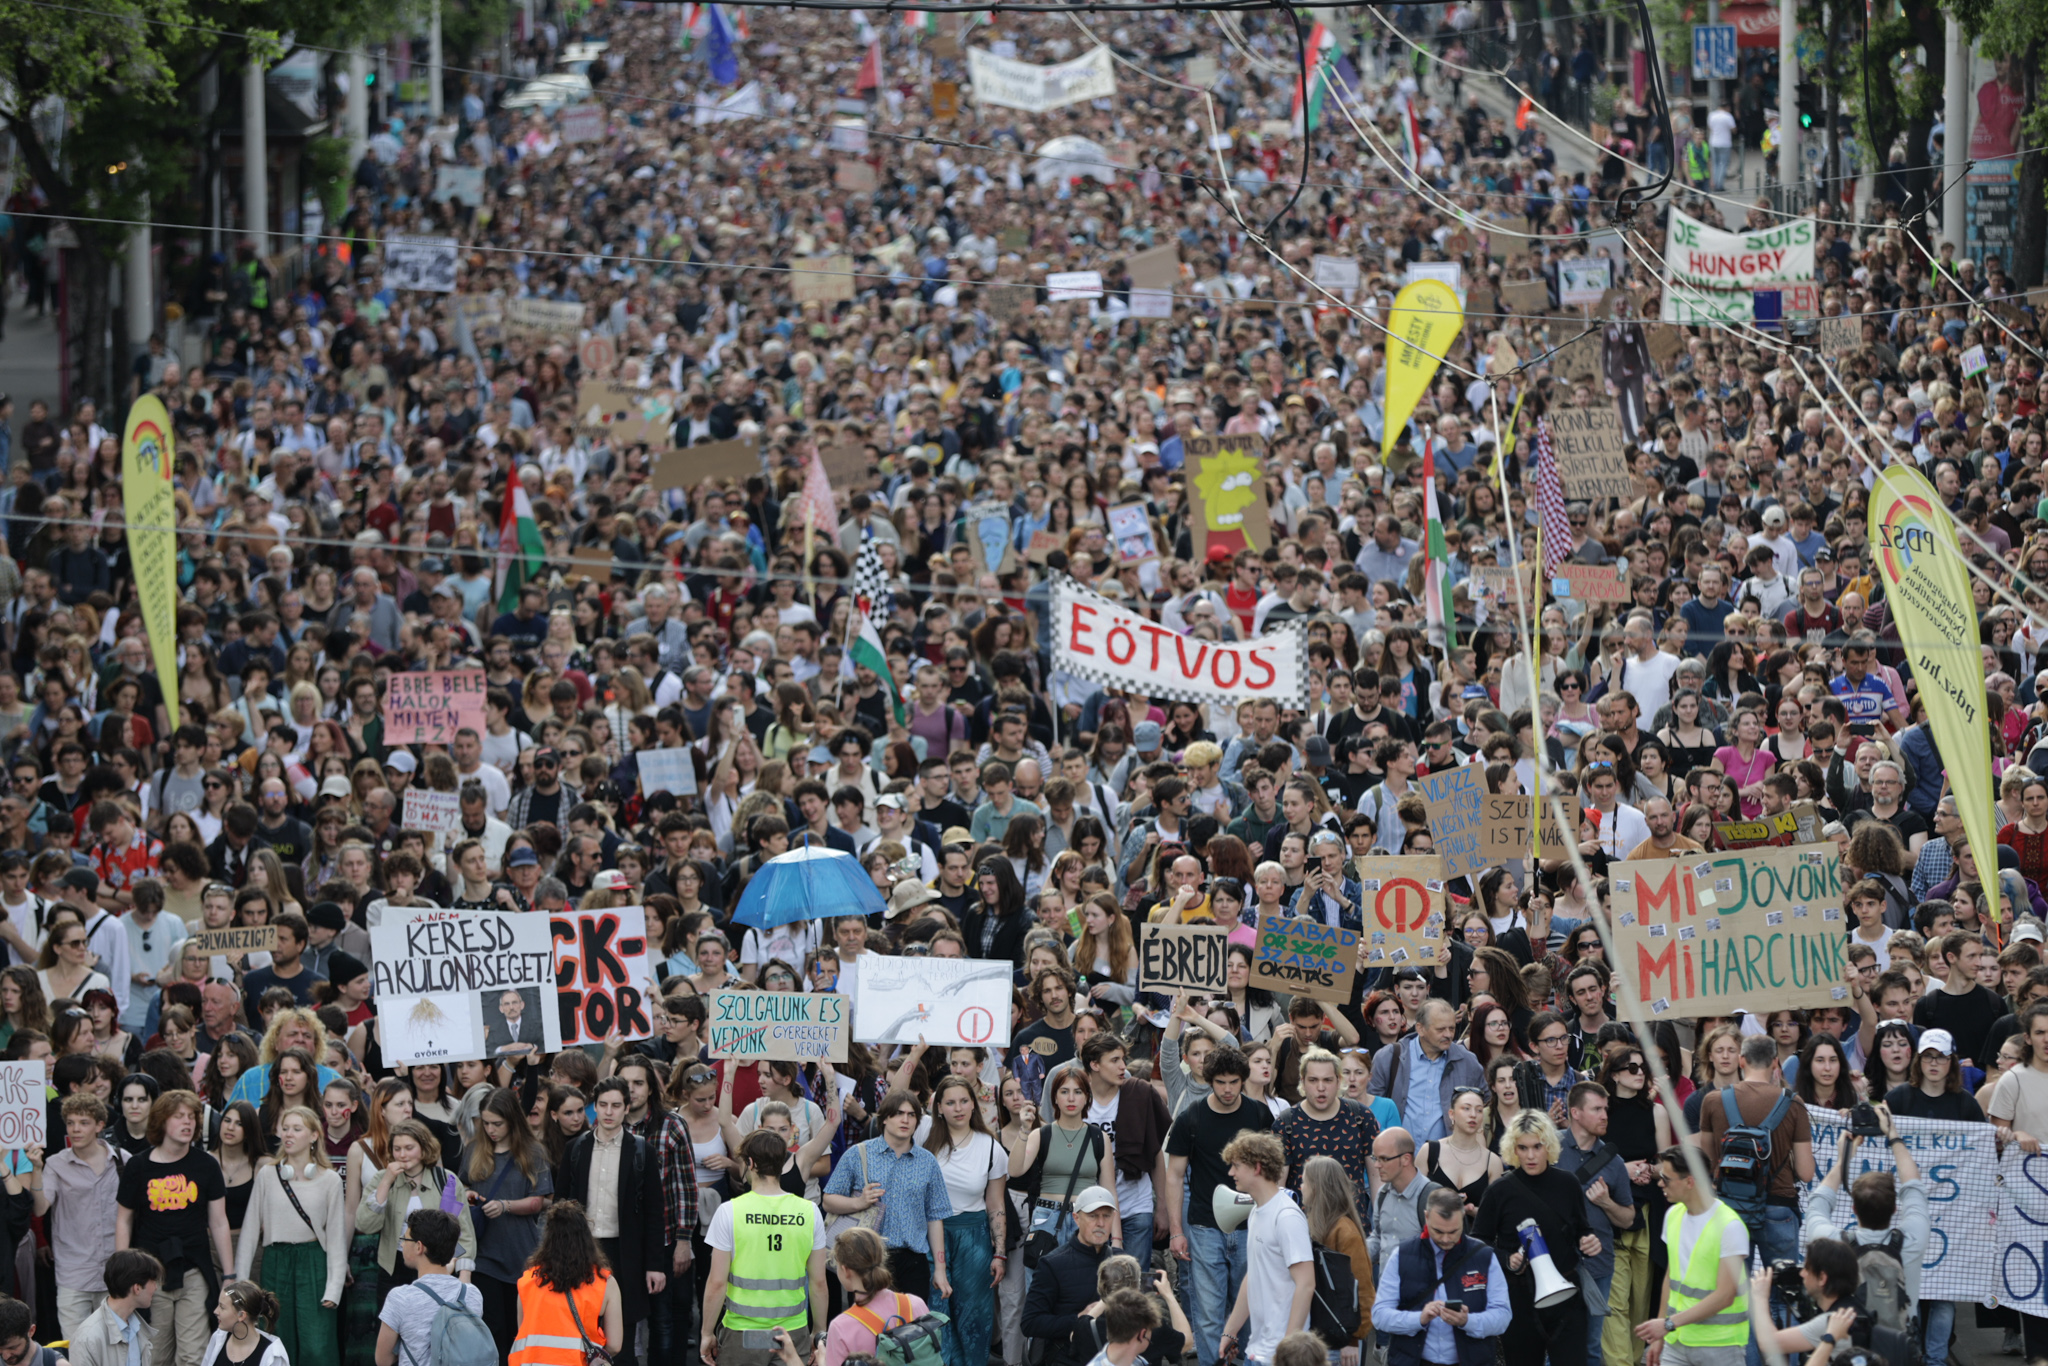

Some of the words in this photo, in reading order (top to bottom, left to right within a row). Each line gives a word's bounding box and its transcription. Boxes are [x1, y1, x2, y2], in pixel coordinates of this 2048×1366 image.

[1674, 218, 1701, 248] JE
[1746, 223, 1811, 250] SUIS
[1689, 249, 1786, 277] HUNGRY
[1572, 580, 1626, 599] SZABAD
[443, 674, 484, 694] BELE
[390, 694, 452, 710] HALOK
[393, 709, 459, 728] MILYEN
[407, 916, 515, 958] KERESD
[1263, 916, 1356, 947] SZABAD
[1255, 946, 1346, 974] SZABAD
[1700, 931, 1848, 997] HARCUNK
[1258, 961, 1334, 987] OKTATÁS
[716, 994, 812, 1022] SZOLGÁLUNK
[414, 1048, 449, 1059] GYÖKÉR
[745, 1212, 806, 1227] RENDEZŐ
[767, 1233, 783, 1252] 13
